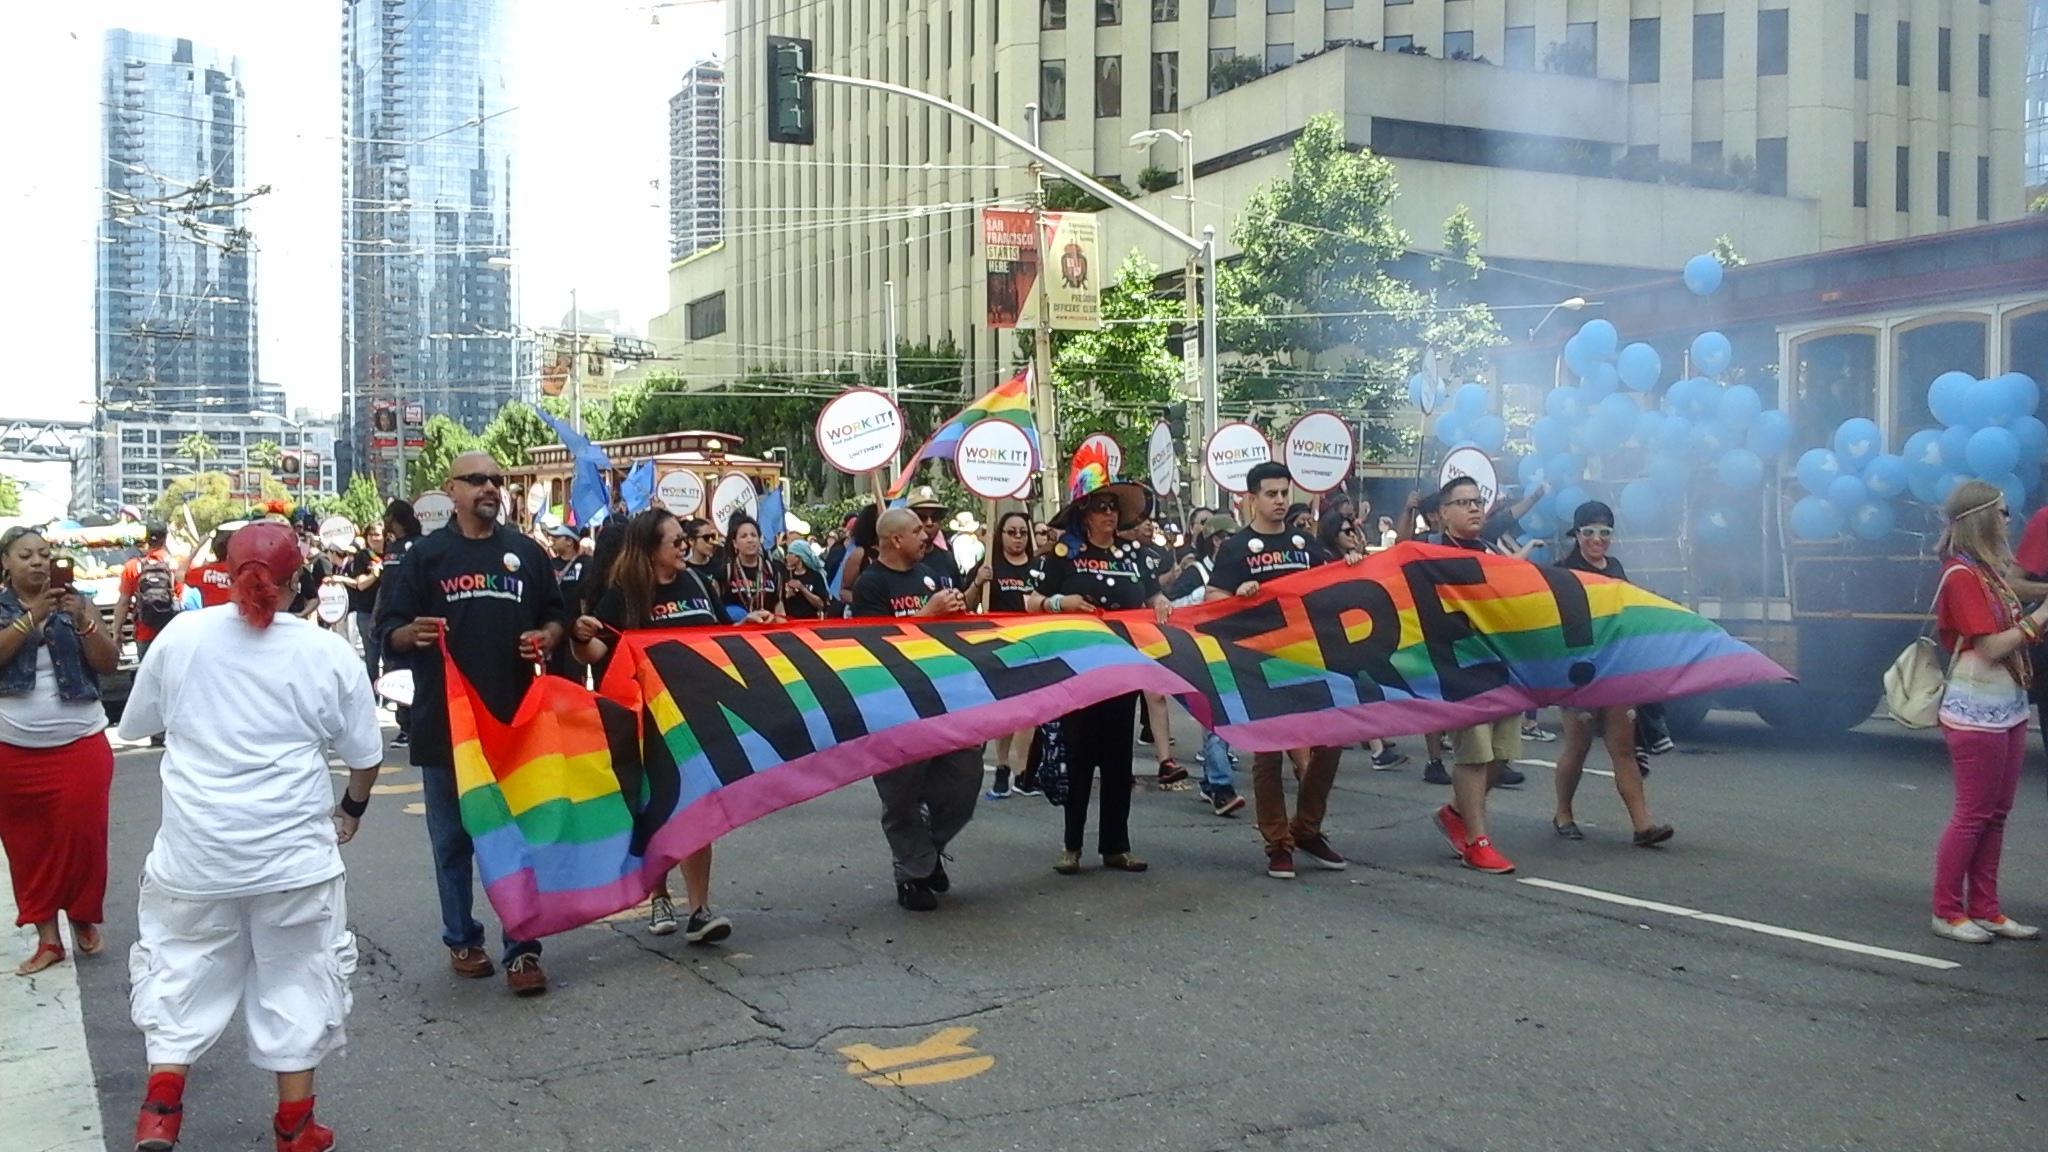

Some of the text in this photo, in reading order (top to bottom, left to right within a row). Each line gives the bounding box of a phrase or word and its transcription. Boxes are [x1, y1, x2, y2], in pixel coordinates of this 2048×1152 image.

[986, 219, 1004, 232] SAN
[986, 231, 1033, 245] FRANCISCO
[988, 246, 1018, 259] STARTS
[988, 260, 1010, 273] HERE
[827, 416, 872, 441] WORK
[875, 410, 895, 426] IT!
[965, 446, 1028, 467] WORK IT!
[1212, 446, 1267, 462] WORK IT!
[1293, 438, 1349, 461] WORK IT!
[661, 486, 699, 499] WORK IT!
[1073, 557, 1118, 572] WORK
[1246, 550, 1311, 571] WORK IT!
[440, 573, 523, 603] WORK IT!
[653, 600, 690, 616] ORK
